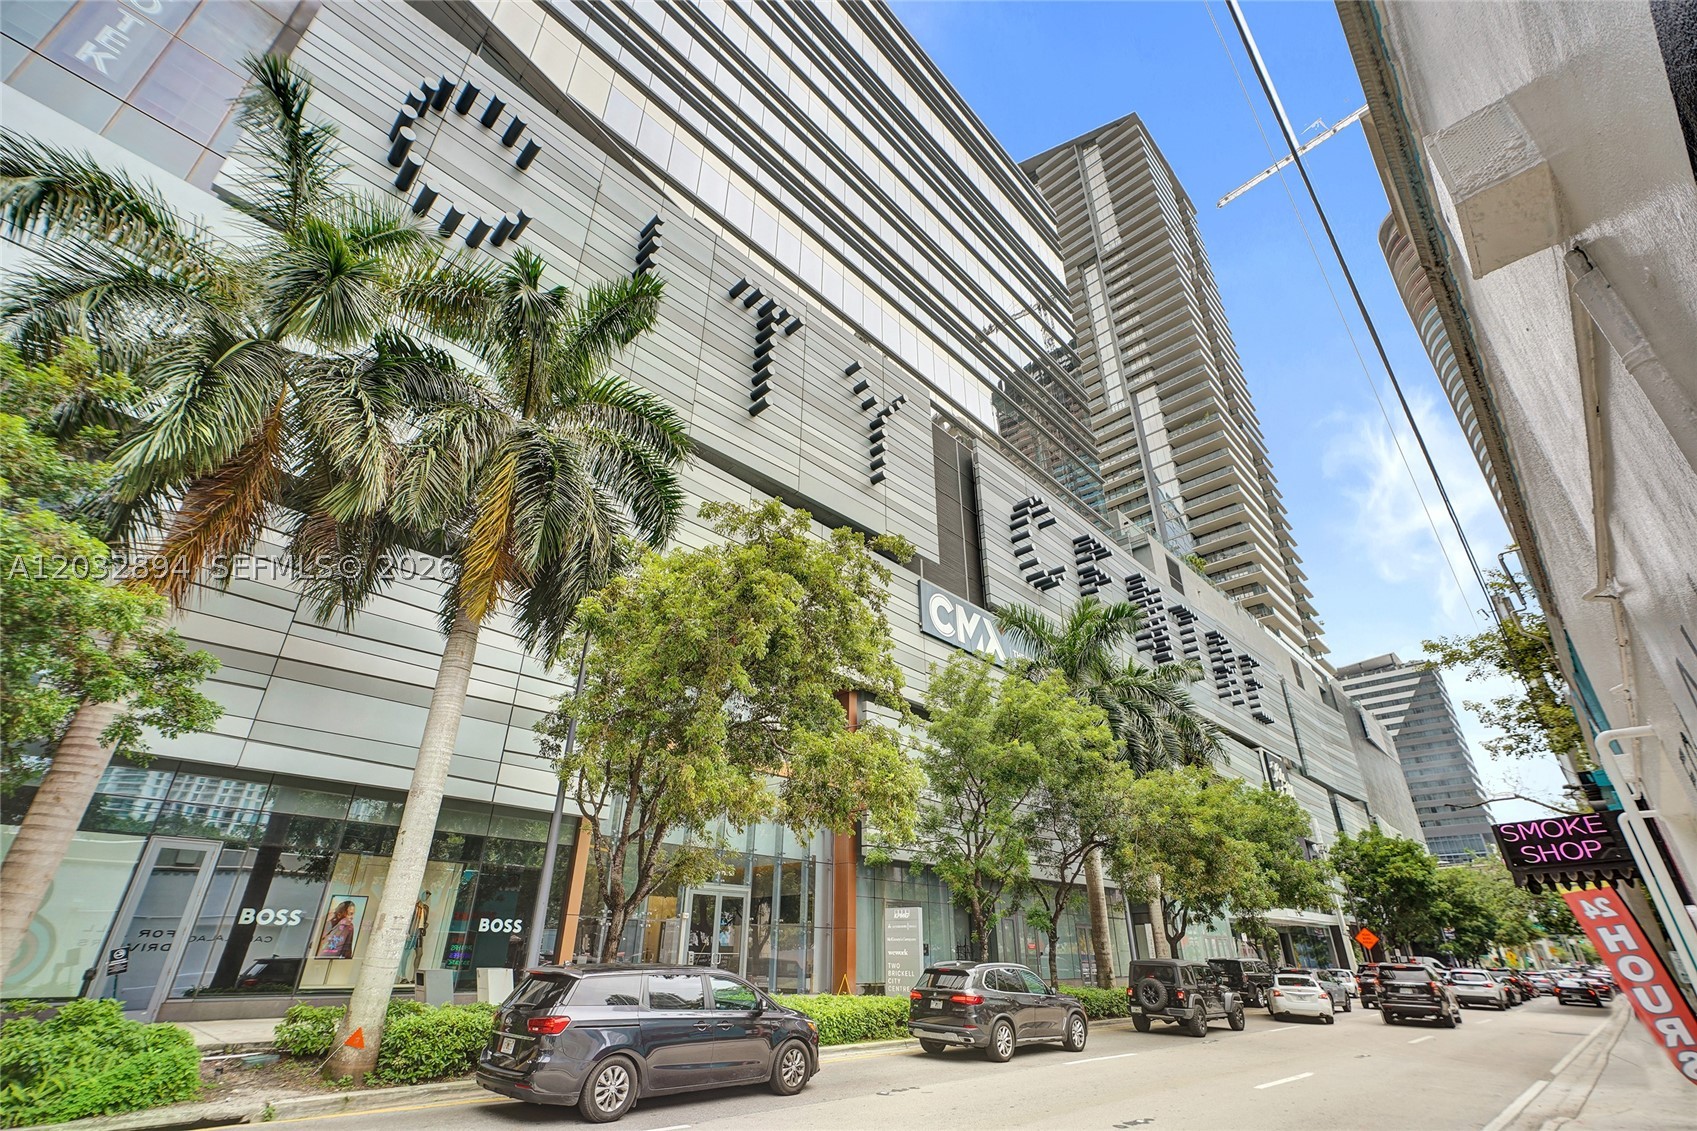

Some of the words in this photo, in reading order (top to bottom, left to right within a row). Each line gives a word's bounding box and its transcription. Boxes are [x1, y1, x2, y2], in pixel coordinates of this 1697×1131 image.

[929, 593, 1007, 661] CMX
[1500, 815, 1607, 842] SMOKE
[1520, 839, 1602, 864] SHOP
[237, 907, 303, 926] BOSS
[478, 918, 523, 933] BOSS
